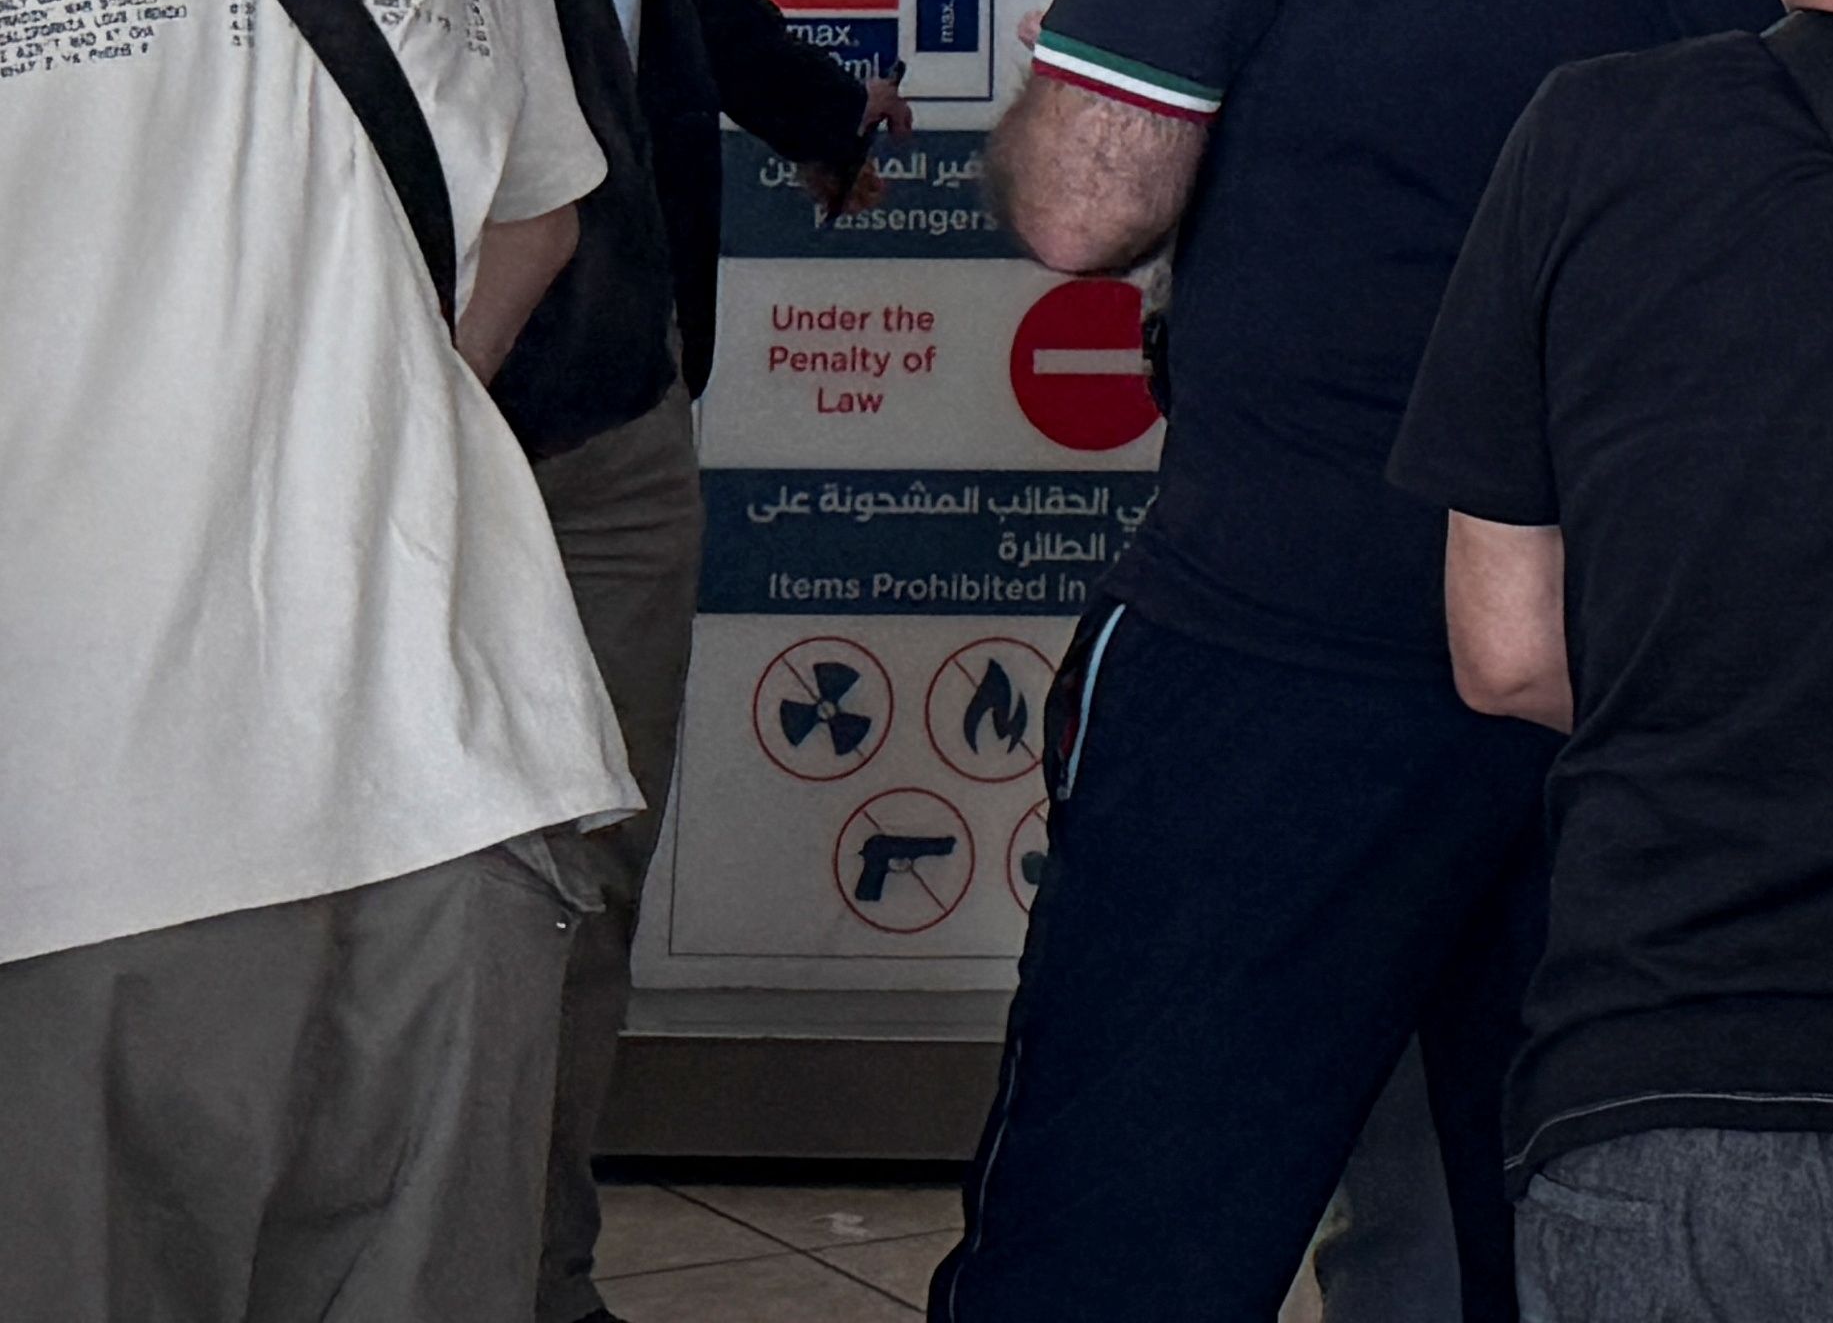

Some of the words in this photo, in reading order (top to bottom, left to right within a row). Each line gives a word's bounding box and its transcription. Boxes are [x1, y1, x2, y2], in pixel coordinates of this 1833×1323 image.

[786, 24, 860, 47] max.
[772, 304, 871, 331] Under
[883, 304, 935, 332] the
[769, 345, 892, 377] Penalty
[903, 345, 936, 373] of
[817, 387, 884, 414] Law
[747, 485, 812, 523] على
[819, 480, 980, 523] المشحونة
[988, 486, 1109, 522] الحقائب
[1000, 533, 1105, 568] الطائرة
[769, 573, 860, 600] Items
[872, 572, 1046, 601] Prohibited
[1058, 573, 1086, 602] in
